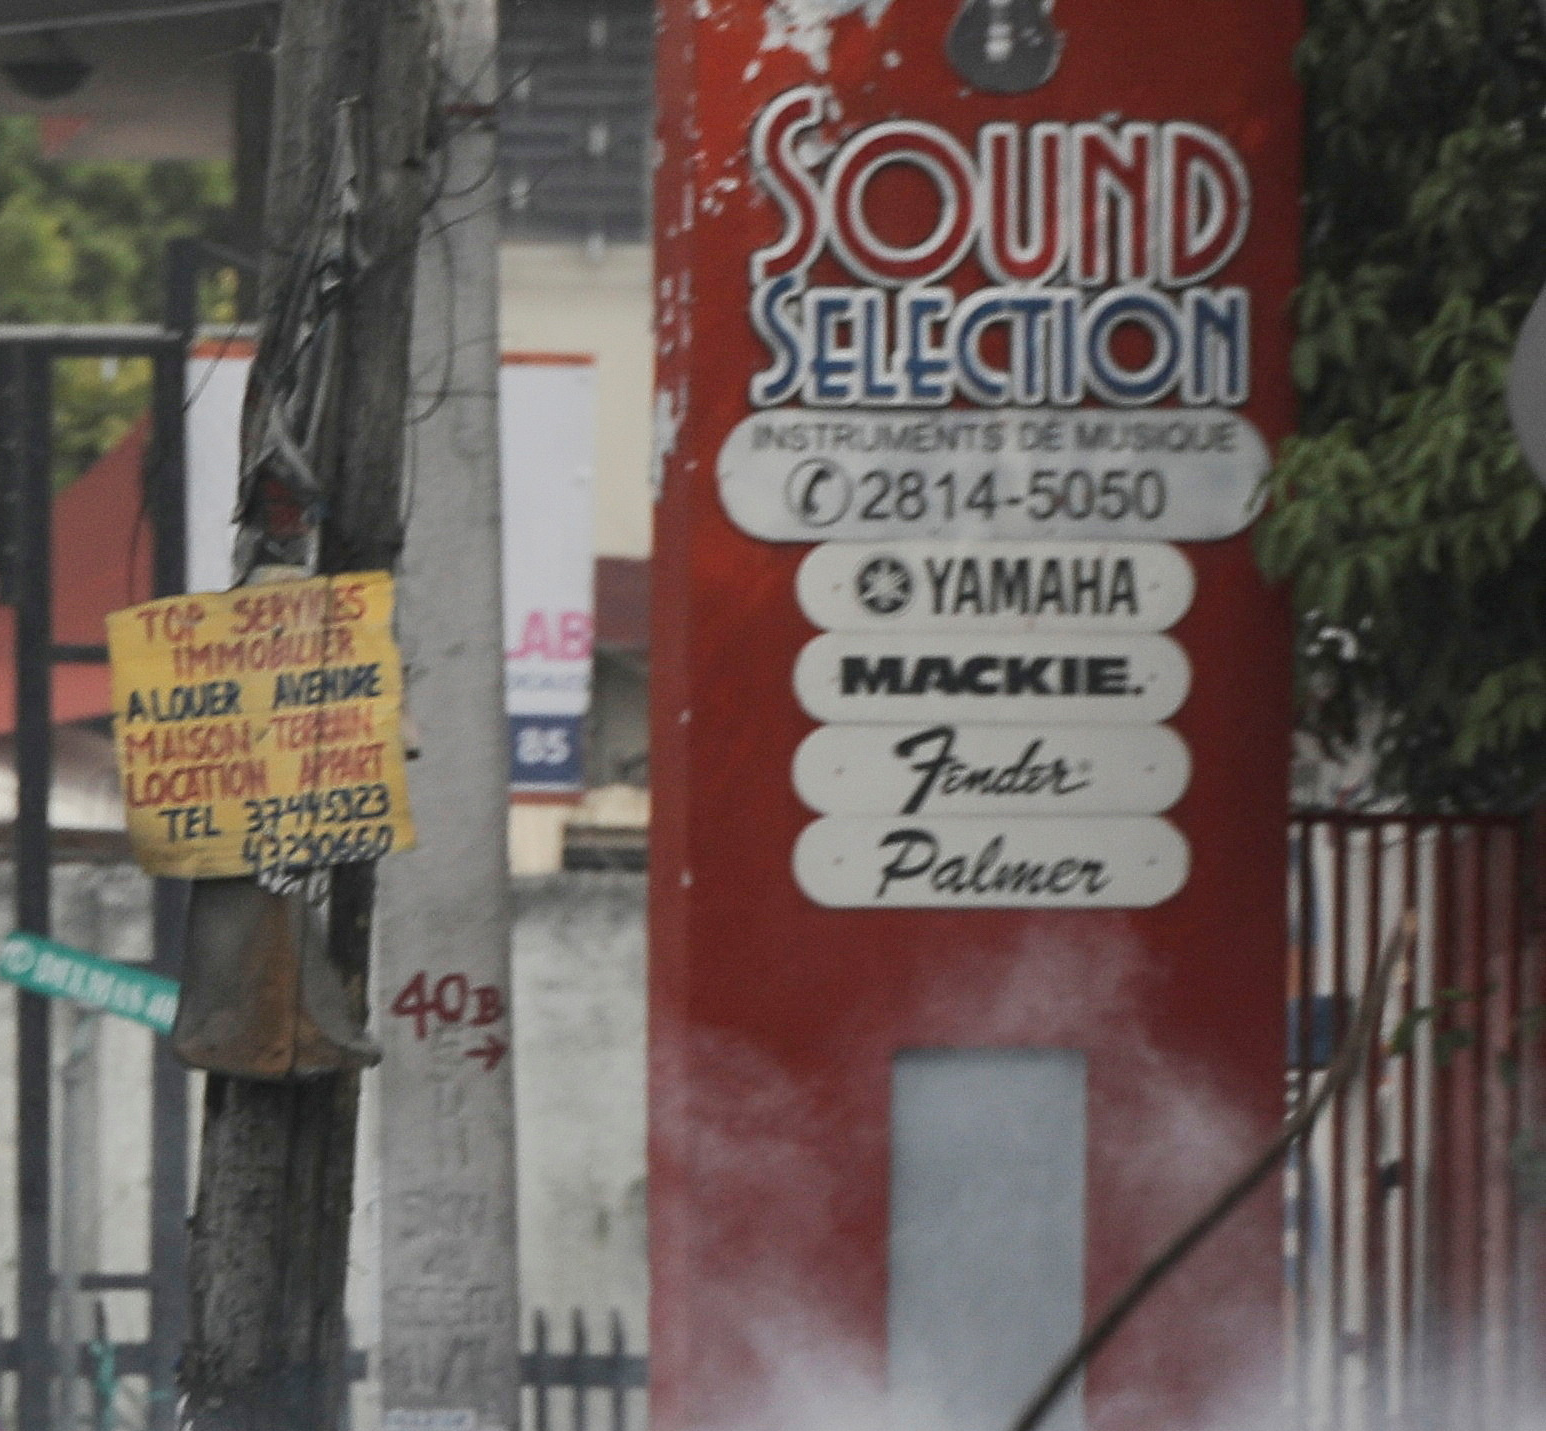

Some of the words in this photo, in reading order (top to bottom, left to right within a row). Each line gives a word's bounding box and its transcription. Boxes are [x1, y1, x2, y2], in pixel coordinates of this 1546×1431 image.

[752, 88, 1252, 289] SOUND
[751, 278, 1252, 409] SELECTION
[752, 421, 1006, 455] INSTRUMENTS
[1015, 422, 1065, 454] DE
[1073, 421, 1238, 456] MUSIQUE
[858, 469, 1169, 524] 2814-5050
[927, 558, 1140, 616] YAMAHA
[895, 727, 1095, 815] Fender
[159, 807, 222, 844] TEL
[876, 829, 1114, 898] Palmer
